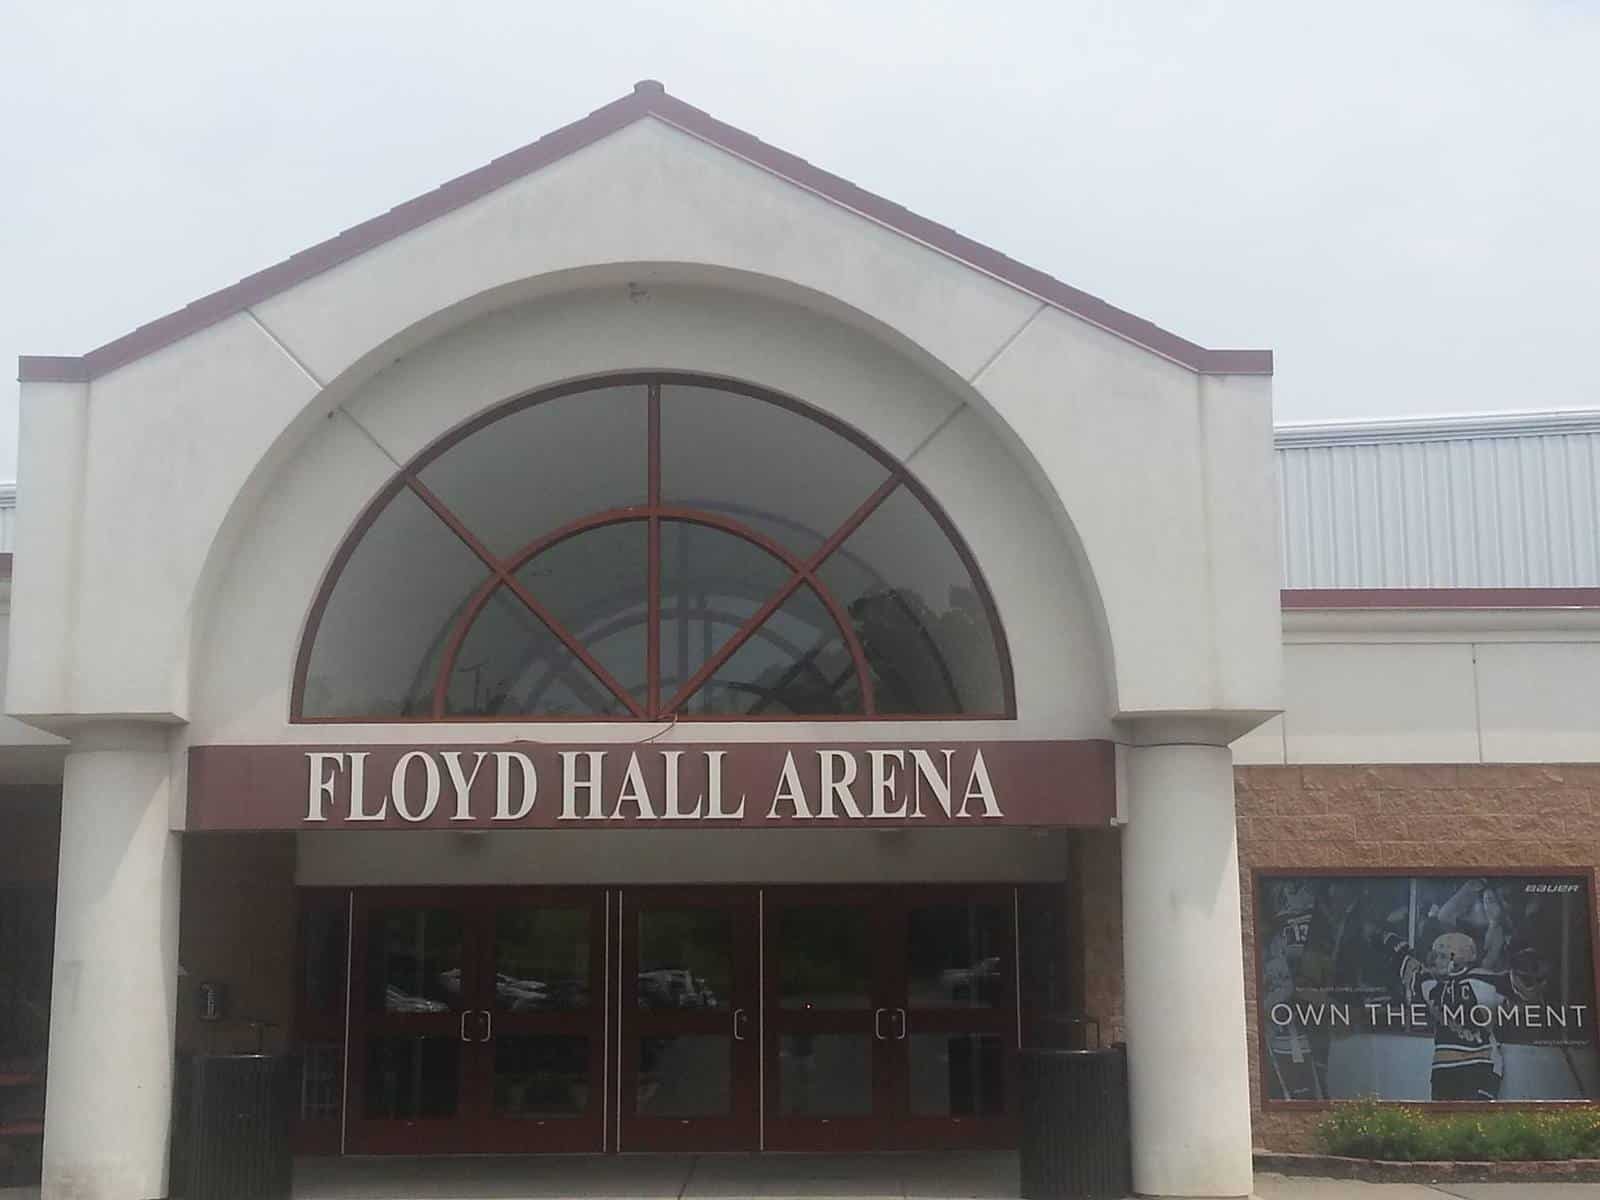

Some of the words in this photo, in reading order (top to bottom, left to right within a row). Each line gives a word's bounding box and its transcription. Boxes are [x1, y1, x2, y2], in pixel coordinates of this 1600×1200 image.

[303, 750, 538, 822] FLOYD
[556, 750, 745, 821] HALL
[766, 748, 1004, 819] ARENA
[1271, 1003, 1351, 1026] OWN
[1364, 1003, 1428, 1026] THE
[1442, 1004, 1588, 1028] MOMENT
